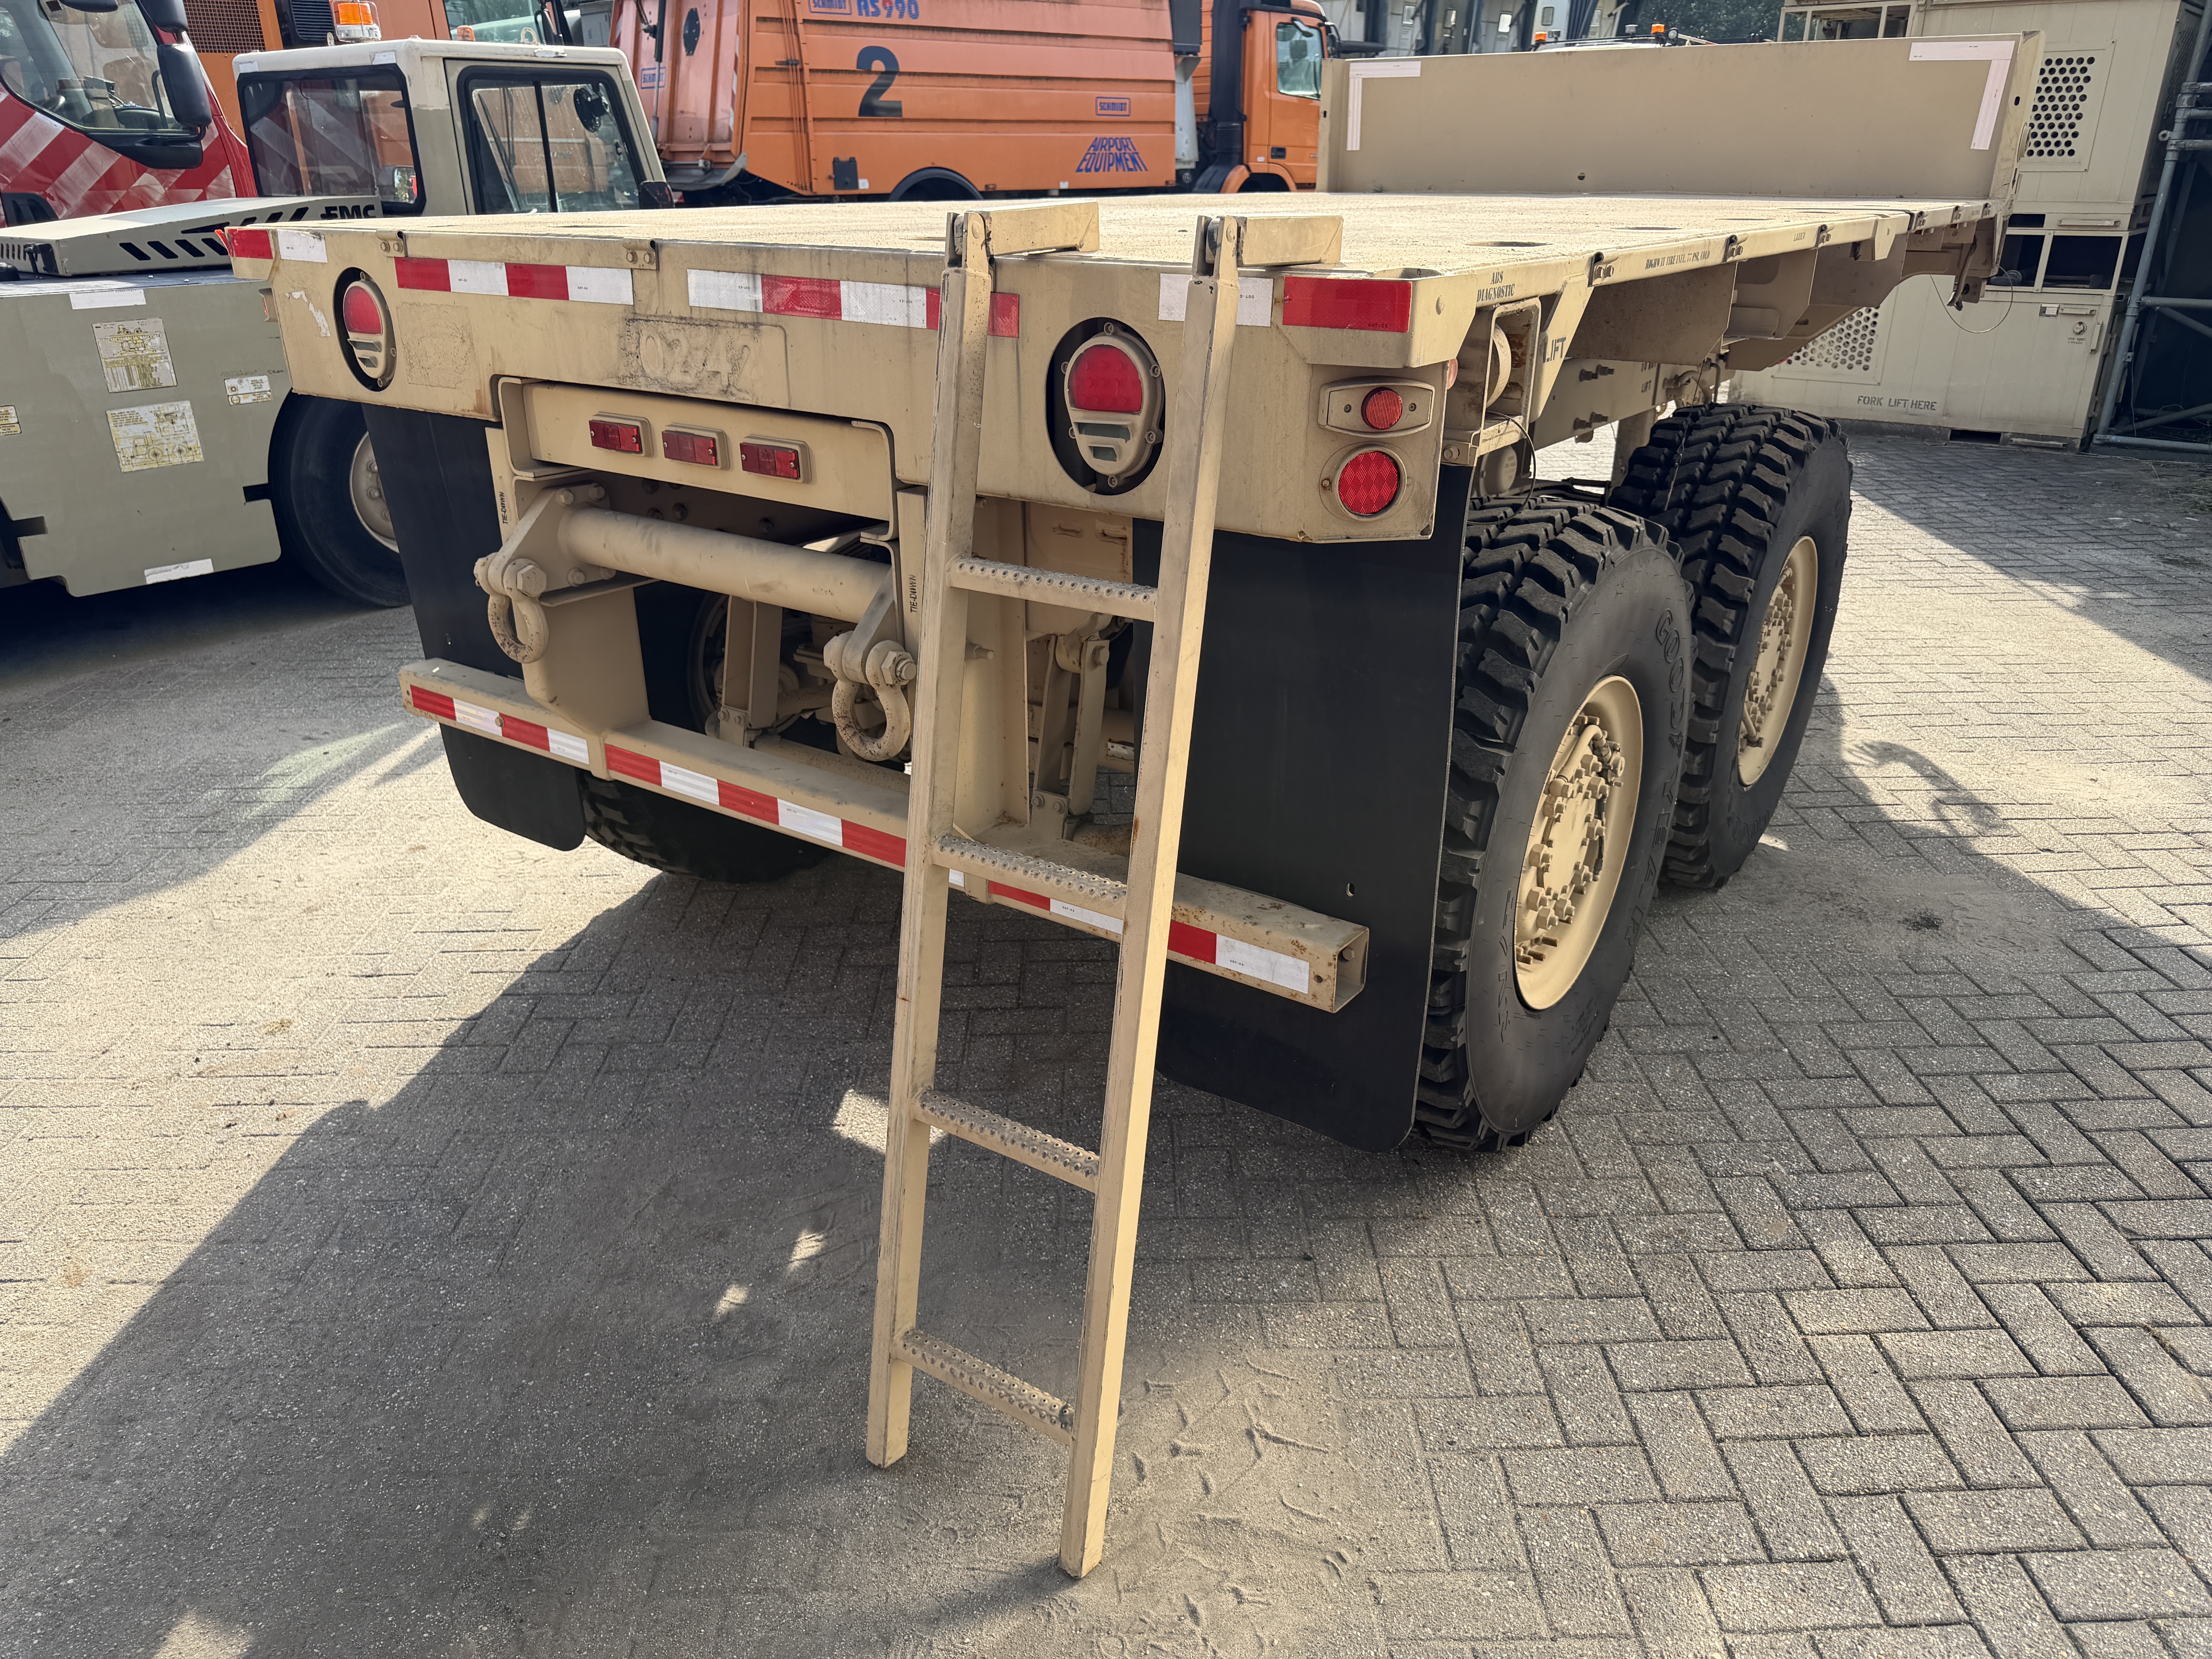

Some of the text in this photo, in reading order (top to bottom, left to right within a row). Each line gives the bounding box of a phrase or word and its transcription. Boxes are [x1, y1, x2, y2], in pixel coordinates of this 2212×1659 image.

[857, 46, 903, 118] 2
[1087, 137, 1137, 152] AIRPORT
[1075, 152, 1149, 173] EQUIPMENT
[1645, 256, 1666, 270] HIGHWAY
[1666, 255, 1676, 266] TIRE
[1700, 251, 1710, 260] COLD
[1491, 271, 1504, 285] ABS
[1477, 283, 1515, 302] DIAGNOSTIC
[1543, 337, 1566, 363] LIFT
[1857, 395, 1937, 410] FORK LIFT HERE
[499, 491, 508, 524] TIE-DOWN
[909, 575, 918, 613] TIE-DOWN
